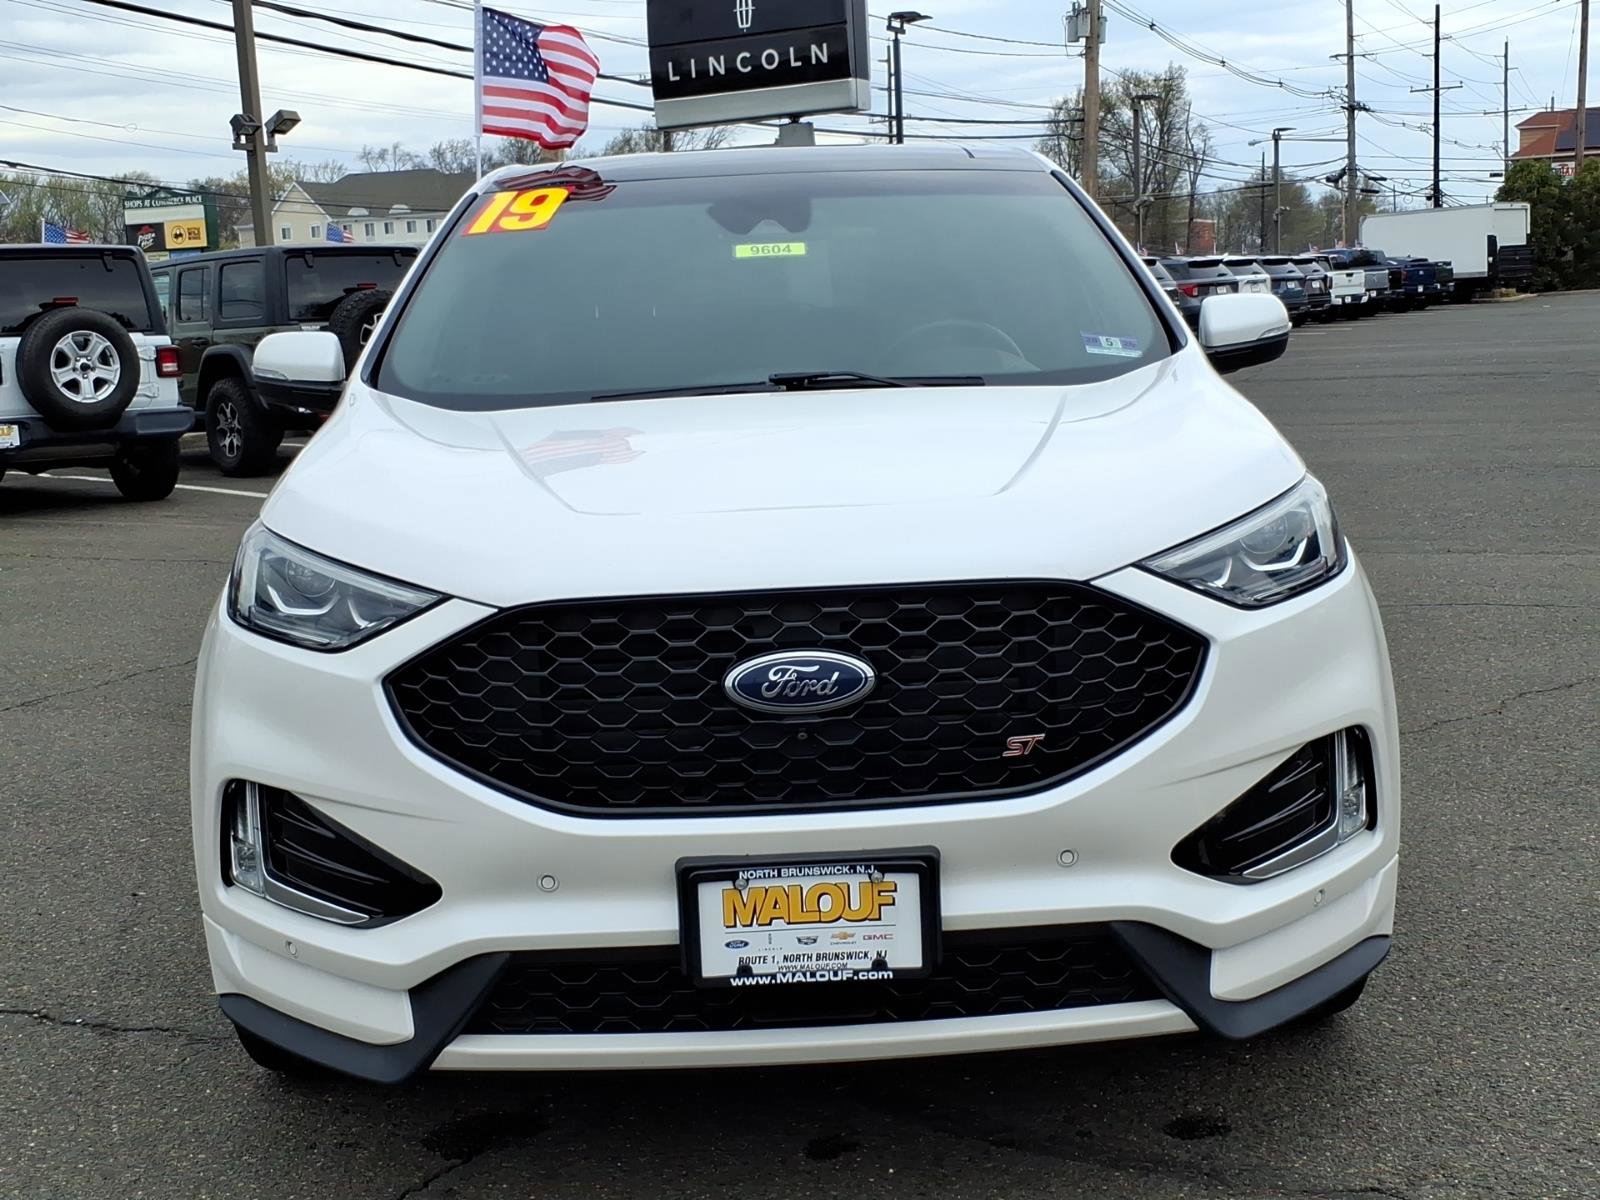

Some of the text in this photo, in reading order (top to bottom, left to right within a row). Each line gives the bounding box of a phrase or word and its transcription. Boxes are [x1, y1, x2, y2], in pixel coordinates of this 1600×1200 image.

[667, 42, 829, 82] LINCOLN
[466, 186, 570, 235] 19
[750, 244, 792, 255] 9604
[761, 665, 840, 699] Ford
[1002, 733, 1046, 757] ST
[739, 868, 778, 880] NORTH
[856, 864, 878, 874] N.J.
[722, 880, 898, 928] MALOUF
[863, 933, 894, 941] GMC
[738, 955, 768, 966] ROUTE
[782, 953, 813, 963] NORTH
[815, 950, 873, 962] BRUNSWICK,
[876, 949, 888, 960] NJ
[778, 962, 848, 972] WWW.MALOUF.COM
[730, 970, 894, 986] www.MALOUF.com
